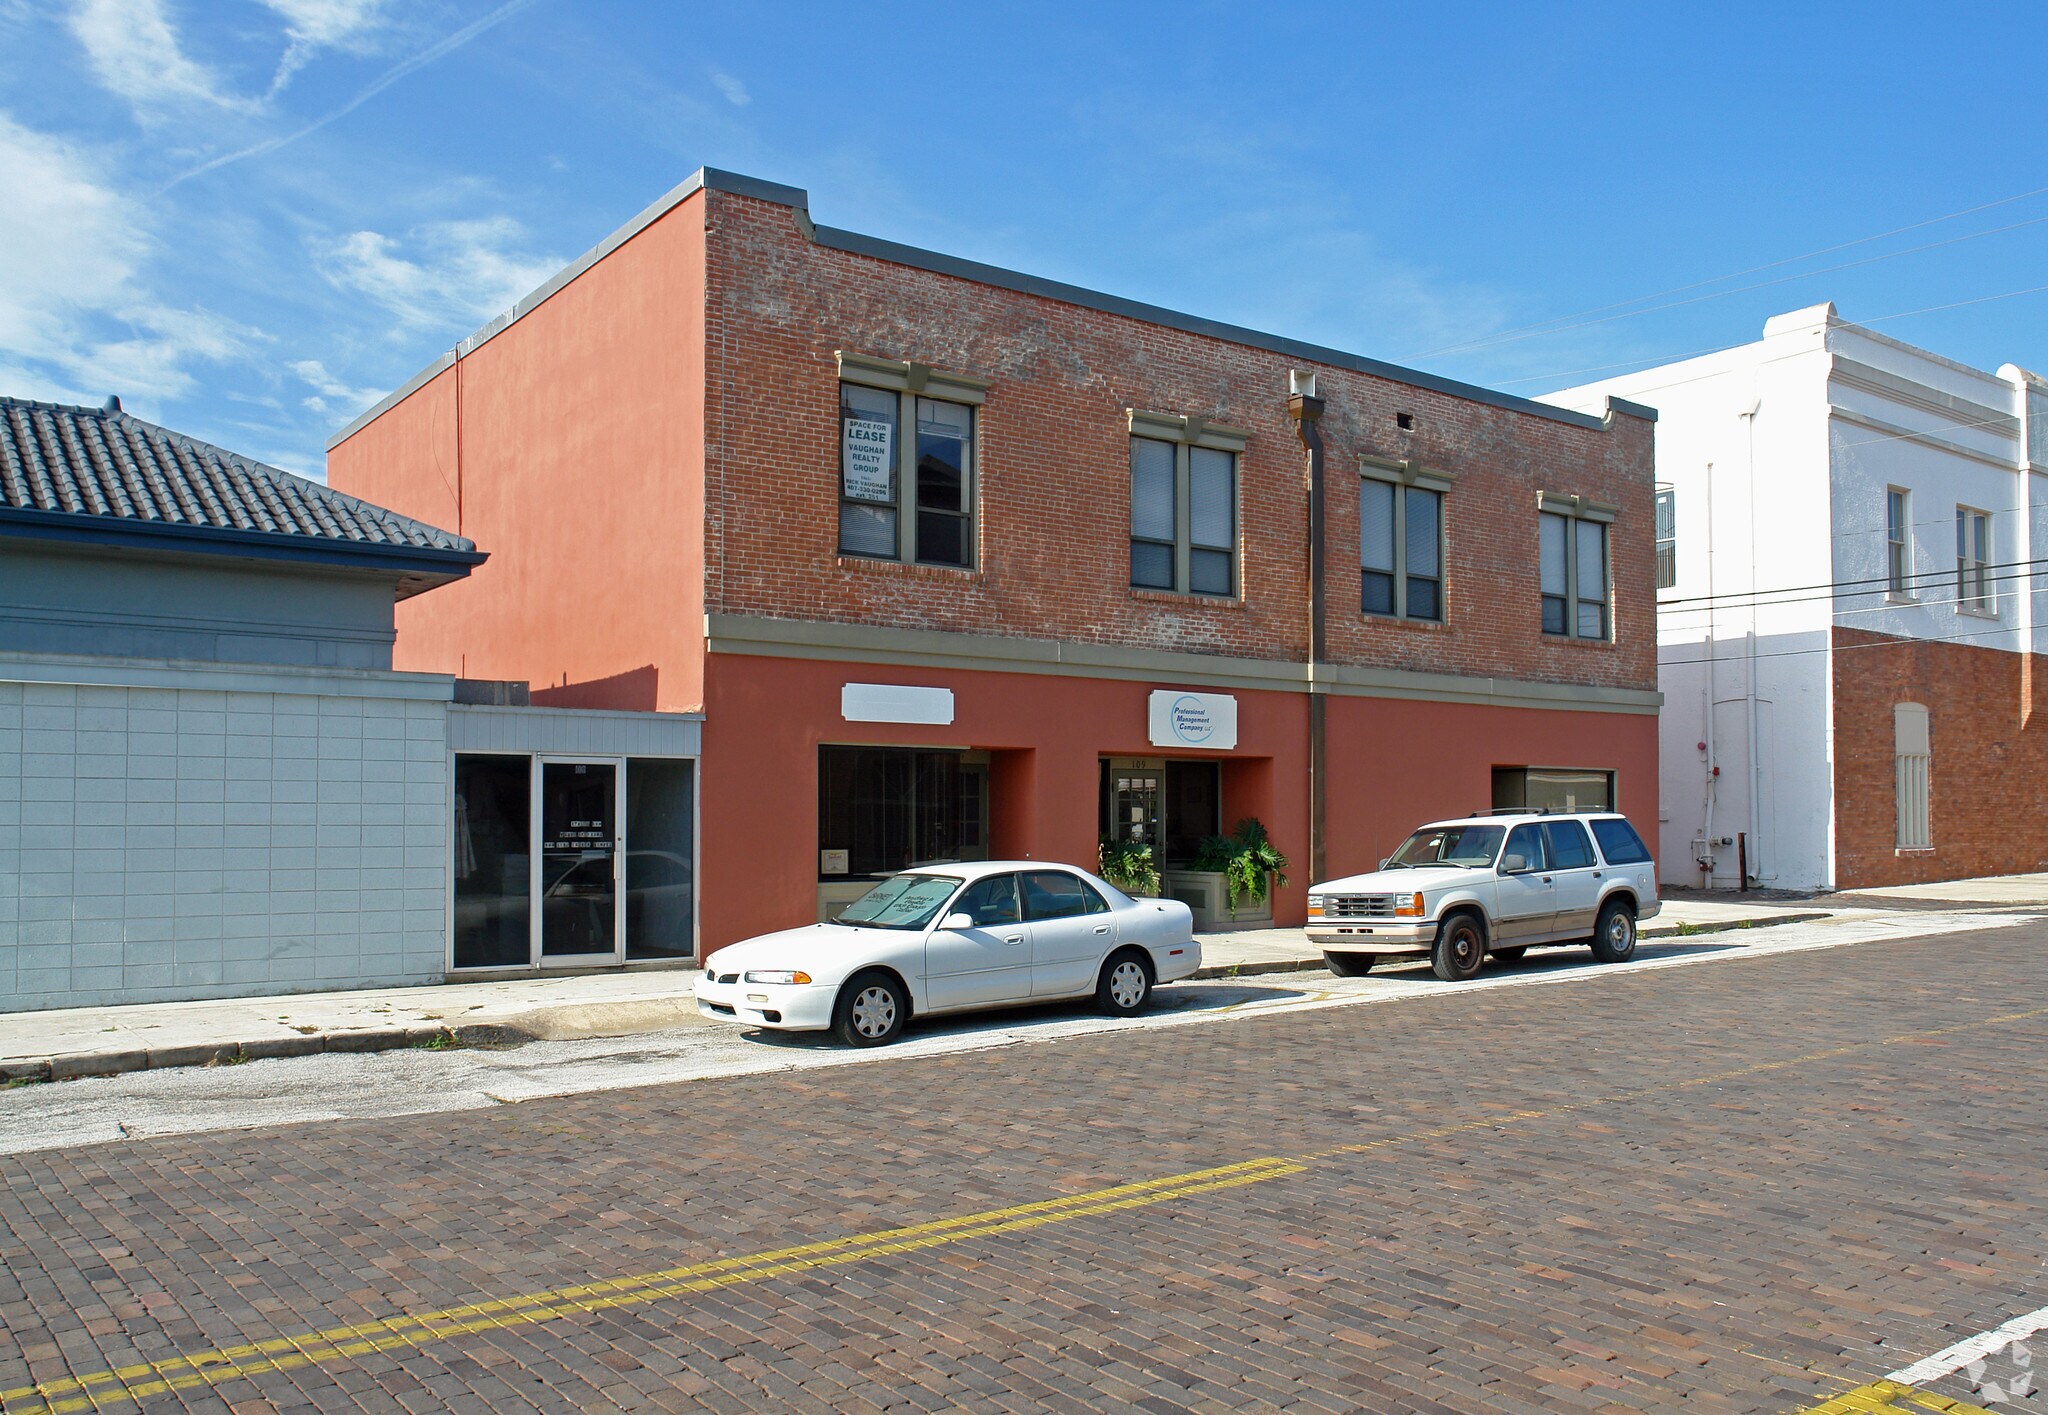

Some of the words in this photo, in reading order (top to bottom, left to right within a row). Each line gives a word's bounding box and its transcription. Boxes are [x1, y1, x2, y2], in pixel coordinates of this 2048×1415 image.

[849, 420, 871, 429] SPACE
[848, 428, 885, 442] LEASE
[848, 443, 884, 454] VAUGHAN
[852, 454, 880, 463] REALTY
[853, 464, 879, 473] GROUP
[860, 480, 887, 489] VAUGHAN
[1174, 707, 1205, 715] Professional
[1177, 715, 1209, 723] Management
[1179, 723, 1203, 732] Company
[1132, 759, 1146, 769] 109
